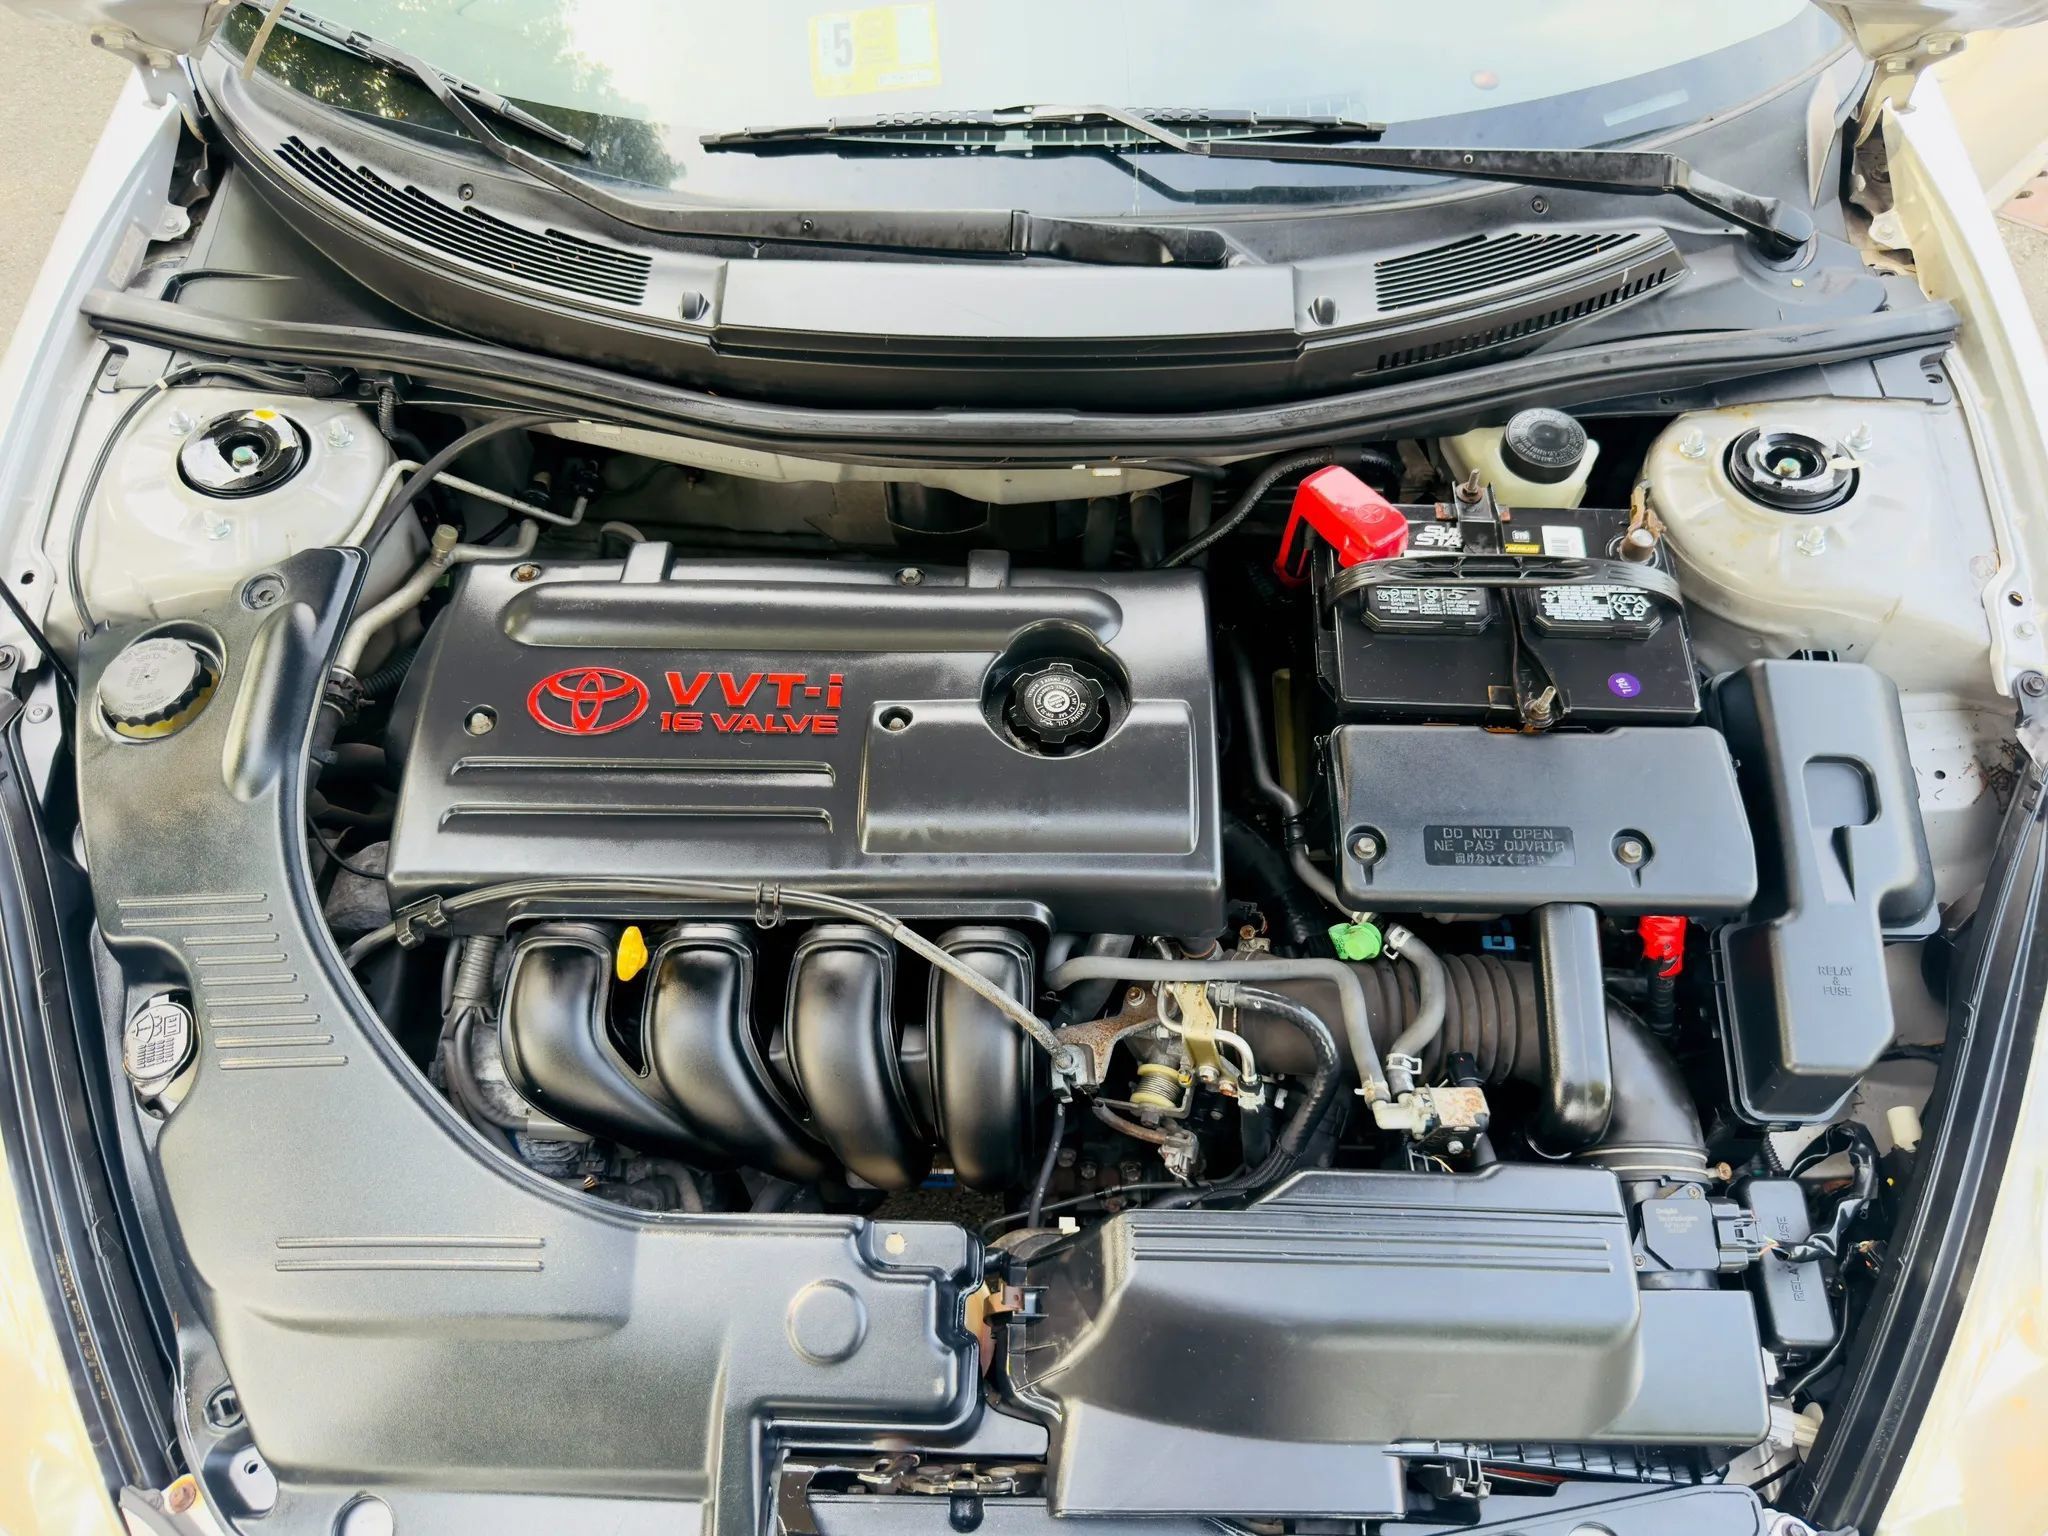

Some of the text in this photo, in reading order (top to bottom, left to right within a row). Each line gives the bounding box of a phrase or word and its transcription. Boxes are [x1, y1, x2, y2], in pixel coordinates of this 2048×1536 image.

[833, 22, 853, 67] 5
[664, 671, 845, 709] VVT-i
[660, 711, 840, 735] 16 VALVE
[1057, 702, 1087, 727] ENGINE OIL
[1443, 827, 1553, 840] DO NOT OPEN
[1434, 839, 1454, 851] NE
[1464, 839, 1495, 851] PAS
[1817, 965, 1853, 976] RELAY
[1823, 985, 1853, 996] FUSE
